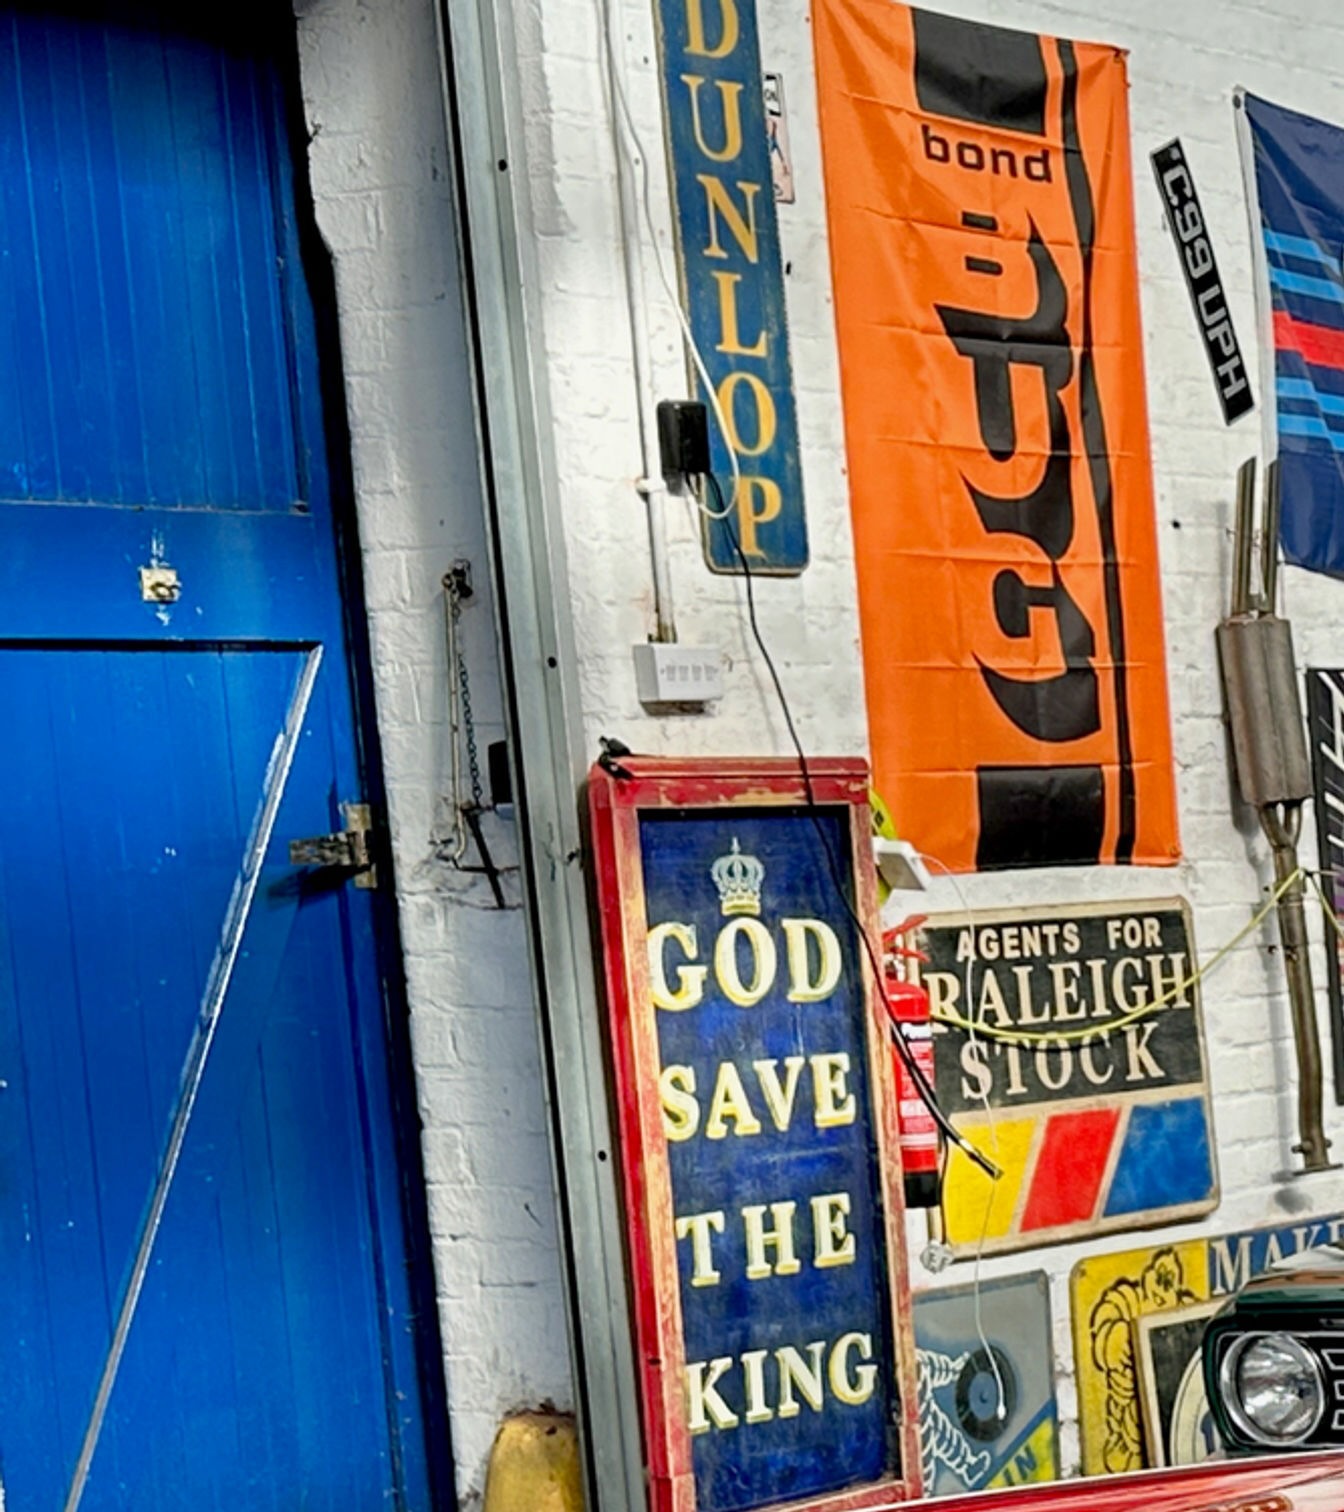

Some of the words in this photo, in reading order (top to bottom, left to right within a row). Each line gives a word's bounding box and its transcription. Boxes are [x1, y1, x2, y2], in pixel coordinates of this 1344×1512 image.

[921, 124, 1054, 184] bond
[682, 0, 783, 558] DUNLOP
[1194, 279, 1249, 400] UPH
[645, 915, 844, 1012] GOD
[956, 921, 1082, 963] AGENTS
[1106, 917, 1163, 951] FOR
[921, 951, 1193, 1036] RALEIGH
[658, 1050, 857, 1142] SAVE
[959, 1020, 1167, 1102] STOCK
[673, 1190, 856, 1288] THE
[684, 1330, 879, 1436] KING
